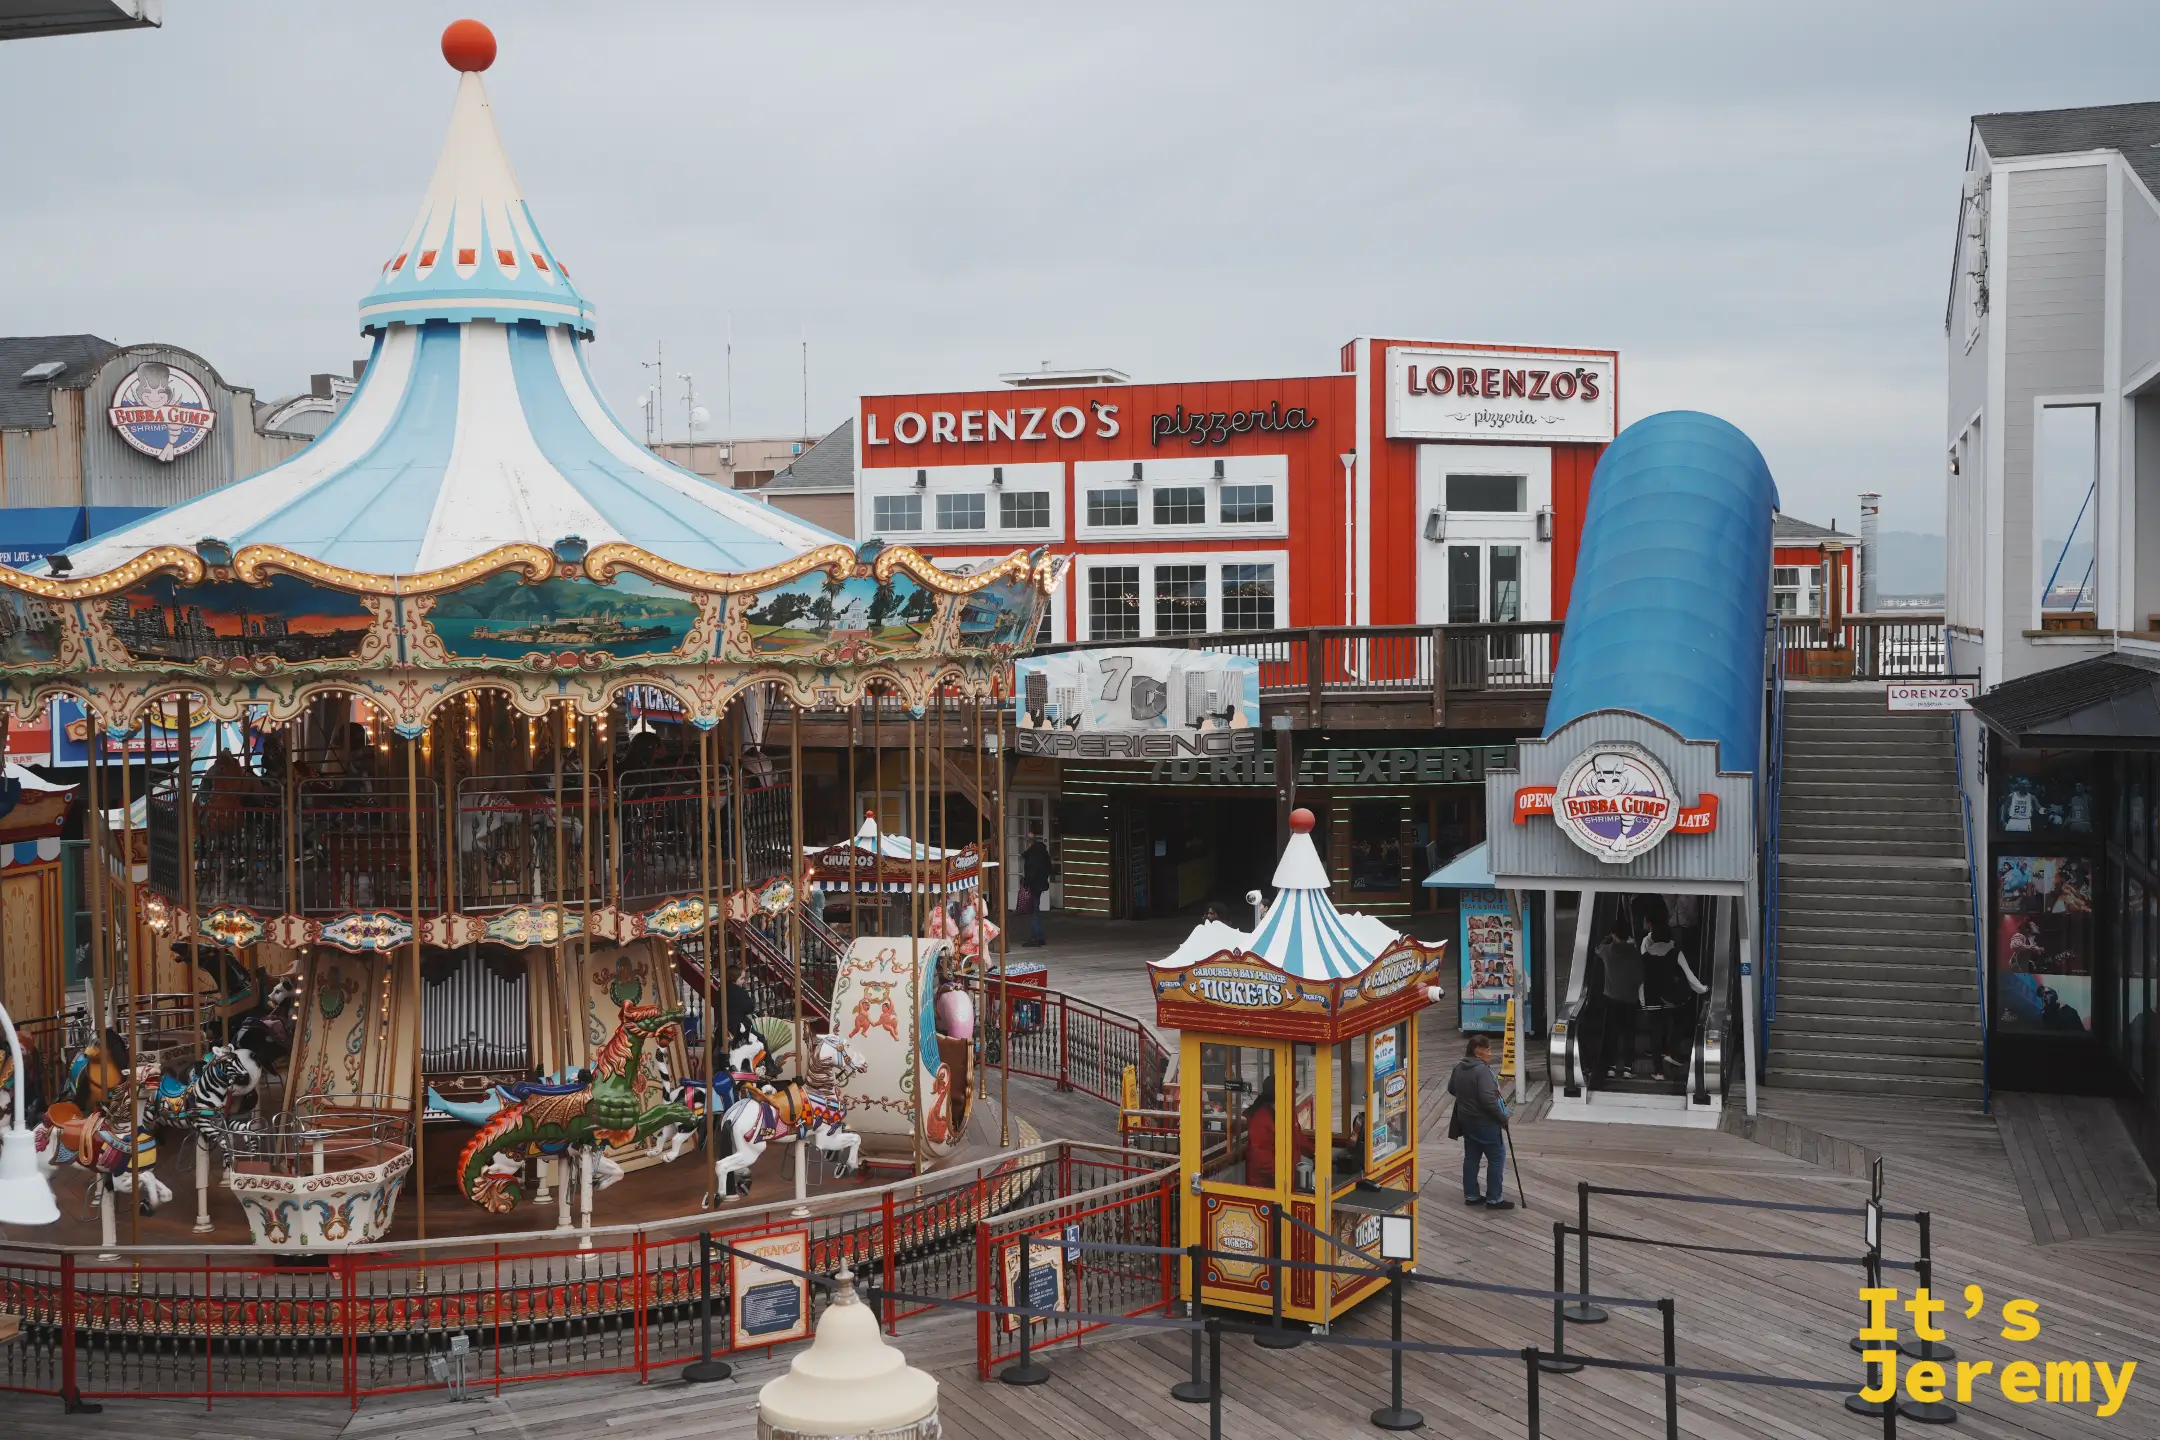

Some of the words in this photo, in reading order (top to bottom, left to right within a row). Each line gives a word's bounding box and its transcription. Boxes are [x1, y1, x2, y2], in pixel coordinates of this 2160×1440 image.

[1408, 365, 1600, 401] LORENZO'S
[115, 409, 165, 424] BUBBA
[168, 407, 211, 426] GUMP
[867, 400, 1121, 445] LORENZO'S
[1151, 401, 1316, 447] pizzeria
[1474, 408, 1537, 428] pizzeria
[130, 424, 167, 433] SHRIMP
[0, 552, 12, 563] PEN
[14, 552, 30, 562] LATE
[1099, 656, 1168, 720] 7D
[1891, 688, 1969, 699] LORENZO'S
[1018, 731, 1256, 758] EXPERIENCE
[1327, 747, 1517, 783] EXPERIE
[1519, 793, 1553, 809] OPEN
[1569, 799, 1618, 817] BUBBA
[1621, 796, 1666, 817] GUMP
[2014, 805, 2027, 813] 23
[1585, 816, 1620, 824] SHRIMP
[1678, 812, 1711, 828] LATE
[1461, 889, 1529, 903] PHOTS
[1193, 968, 1232, 978] CAROUSEL
[1240, 969, 1255, 979] BAY
[1256, 972, 1287, 984] PLUNGE
[1371, 957, 1417, 989] CAROUSEL
[1199, 979, 1284, 1006] TICKETS
[1355, 1215, 1381, 1249] TICKE
[1222, 1237, 1253, 1250] TICKETS
[740, 1241, 801, 1270] ETRANCE
